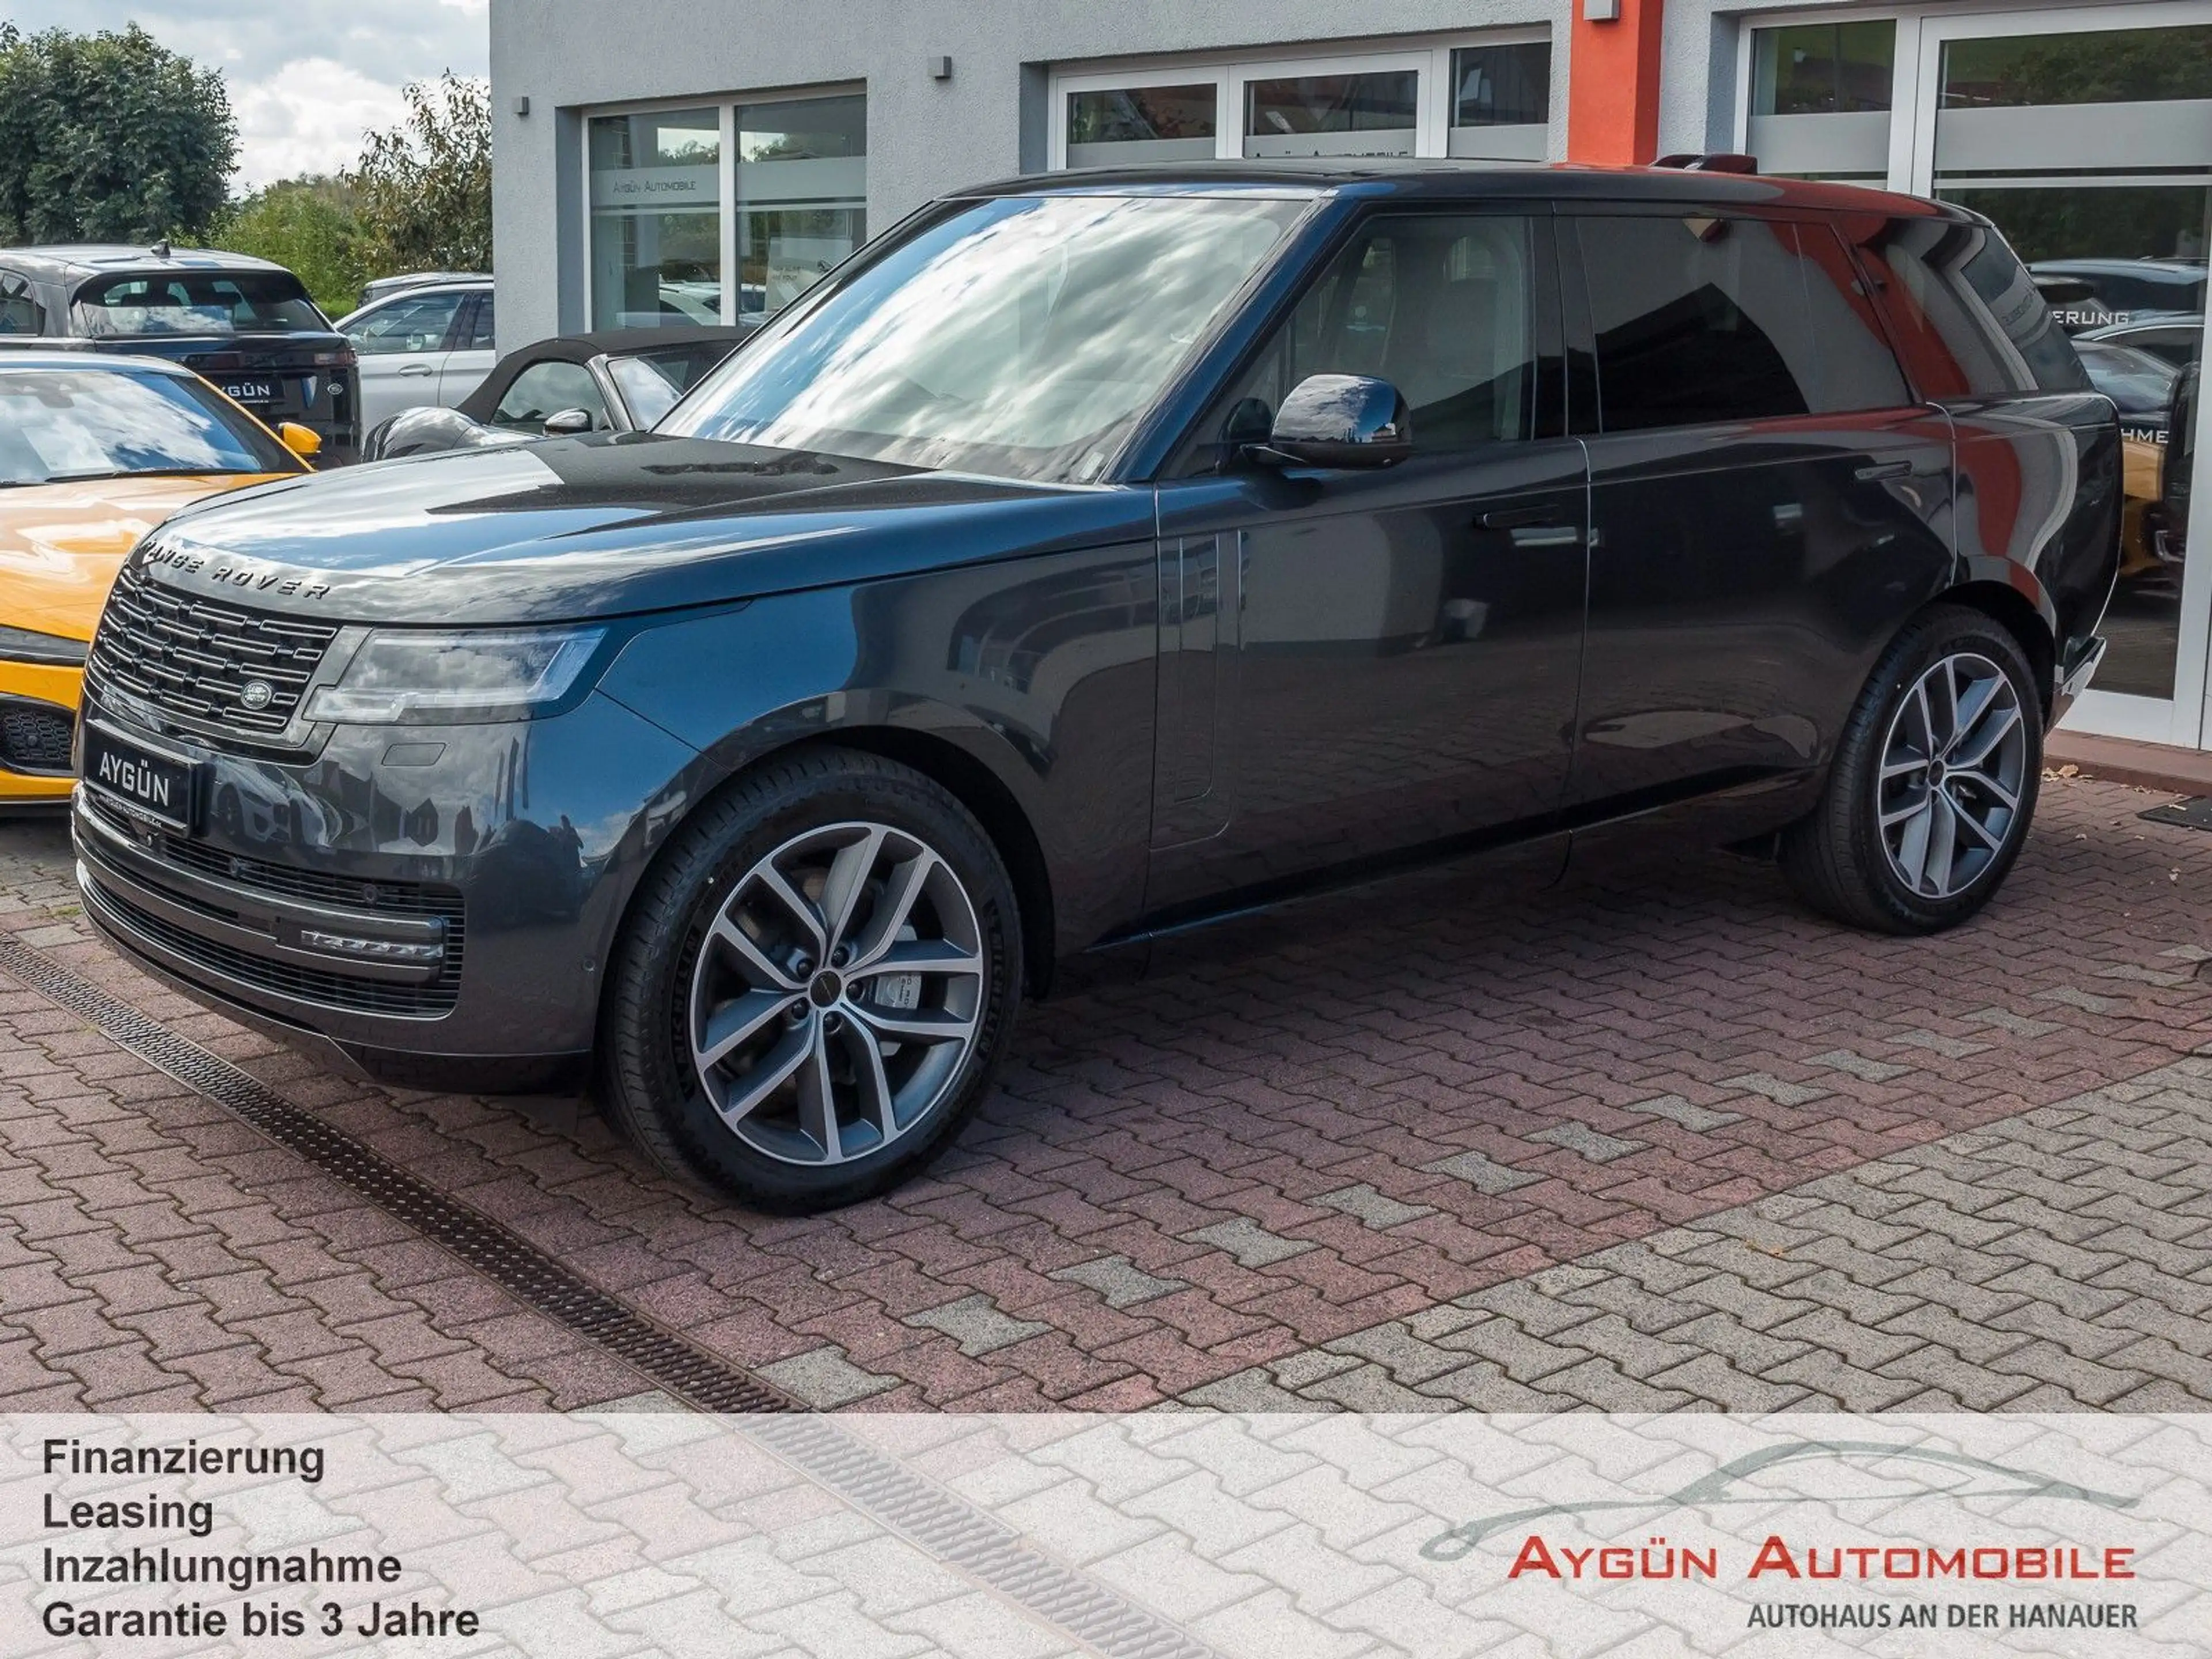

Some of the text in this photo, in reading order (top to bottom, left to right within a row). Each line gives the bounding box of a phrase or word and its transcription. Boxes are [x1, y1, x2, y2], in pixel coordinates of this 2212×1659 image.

[644, 180, 696, 192] AUTOMOBILE
[142, 539, 330, 599] RANGE ROVER
[100, 752, 169, 806] AYGÜN
